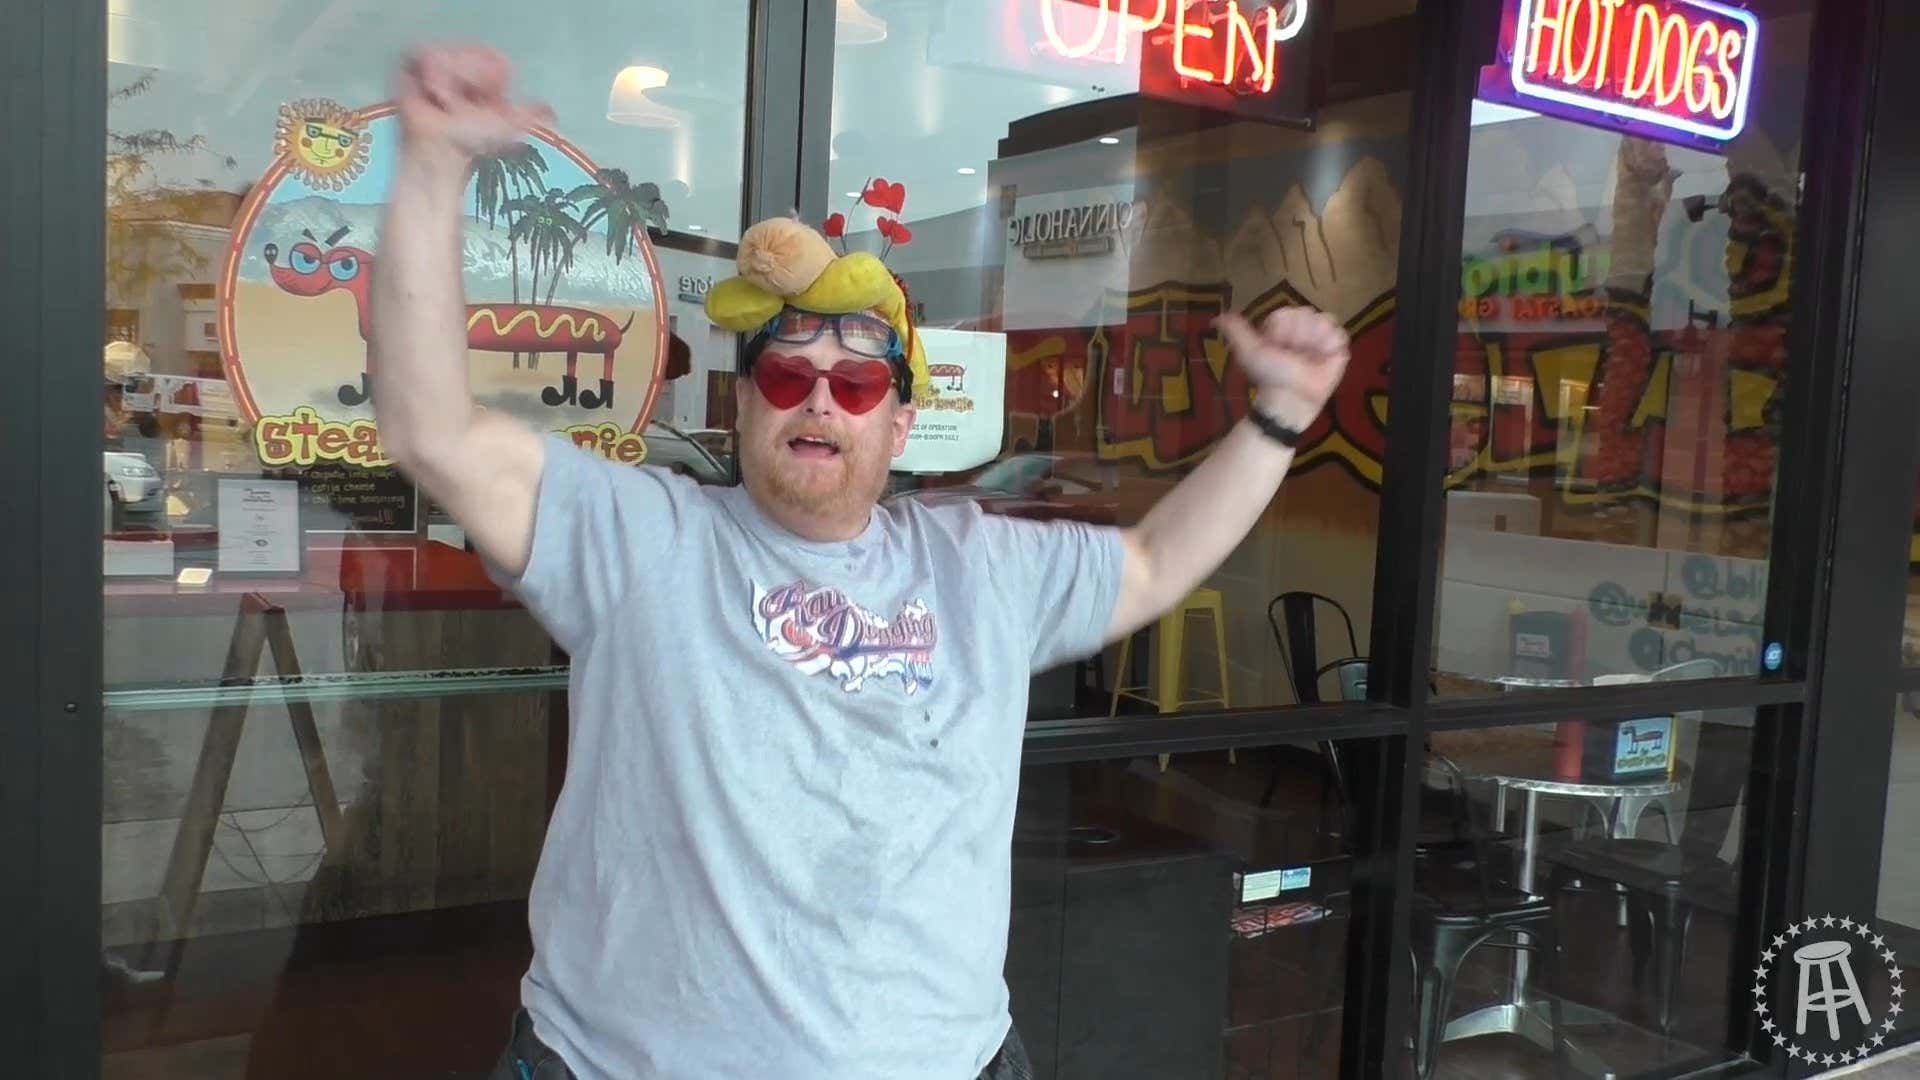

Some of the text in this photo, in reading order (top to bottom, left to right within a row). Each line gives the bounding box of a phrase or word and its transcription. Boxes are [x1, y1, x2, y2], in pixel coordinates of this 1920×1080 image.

[1040, 0, 1278, 92] OPEN
[1526, 0, 1741, 120] HOT DOGS
